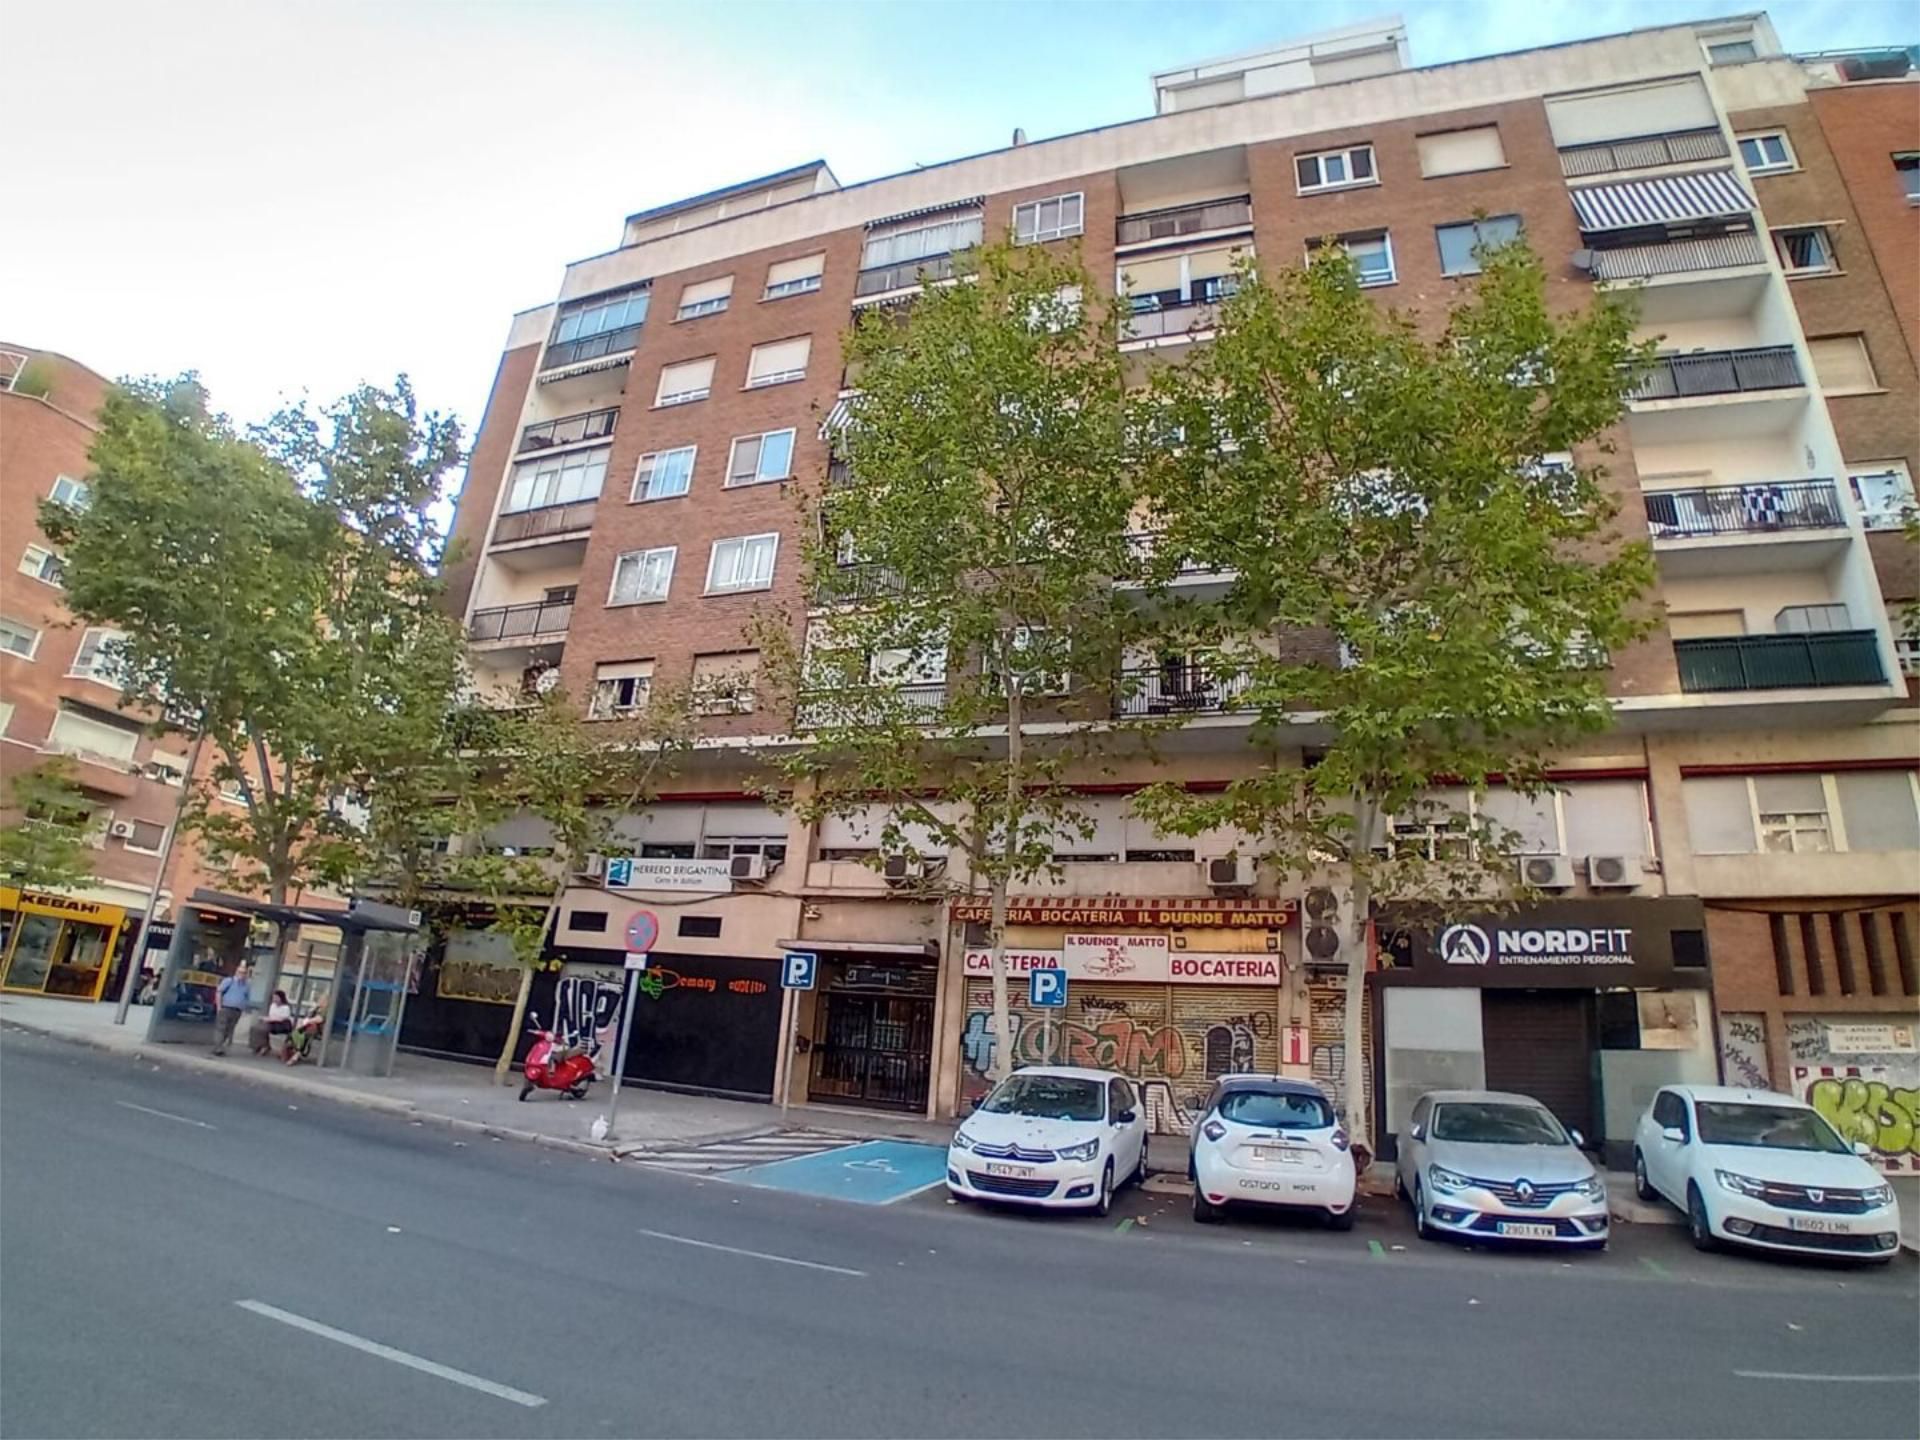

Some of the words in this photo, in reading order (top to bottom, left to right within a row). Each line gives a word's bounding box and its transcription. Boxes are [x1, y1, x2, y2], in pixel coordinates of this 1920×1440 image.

[634, 865, 671, 875] HERRERO
[674, 865, 728, 876] BRIGANTINA
[955, 908, 1033, 921] CAFERIA
[1041, 910, 1124, 923] BOCATERIA
[1138, 912, 1152, 923] IL
[1159, 912, 1223, 924] DUENDE
[1231, 913, 1287, 924] MATTO
[1067, 937, 1076, 946] IL
[1078, 937, 1119, 947] DUENDE
[1127, 938, 1165, 947] MATTO
[1498, 929, 1632, 953] NORDFIT
[966, 954, 1058, 970] CATERIA
[1171, 959, 1277, 978] BOCATERIA
[1499, 955, 1581, 965] ENTRENAMIENTO
[1583, 955, 1635, 965] PERSONAL
[788, 958, 808, 985] P
[1035, 973, 1057, 1002] P
